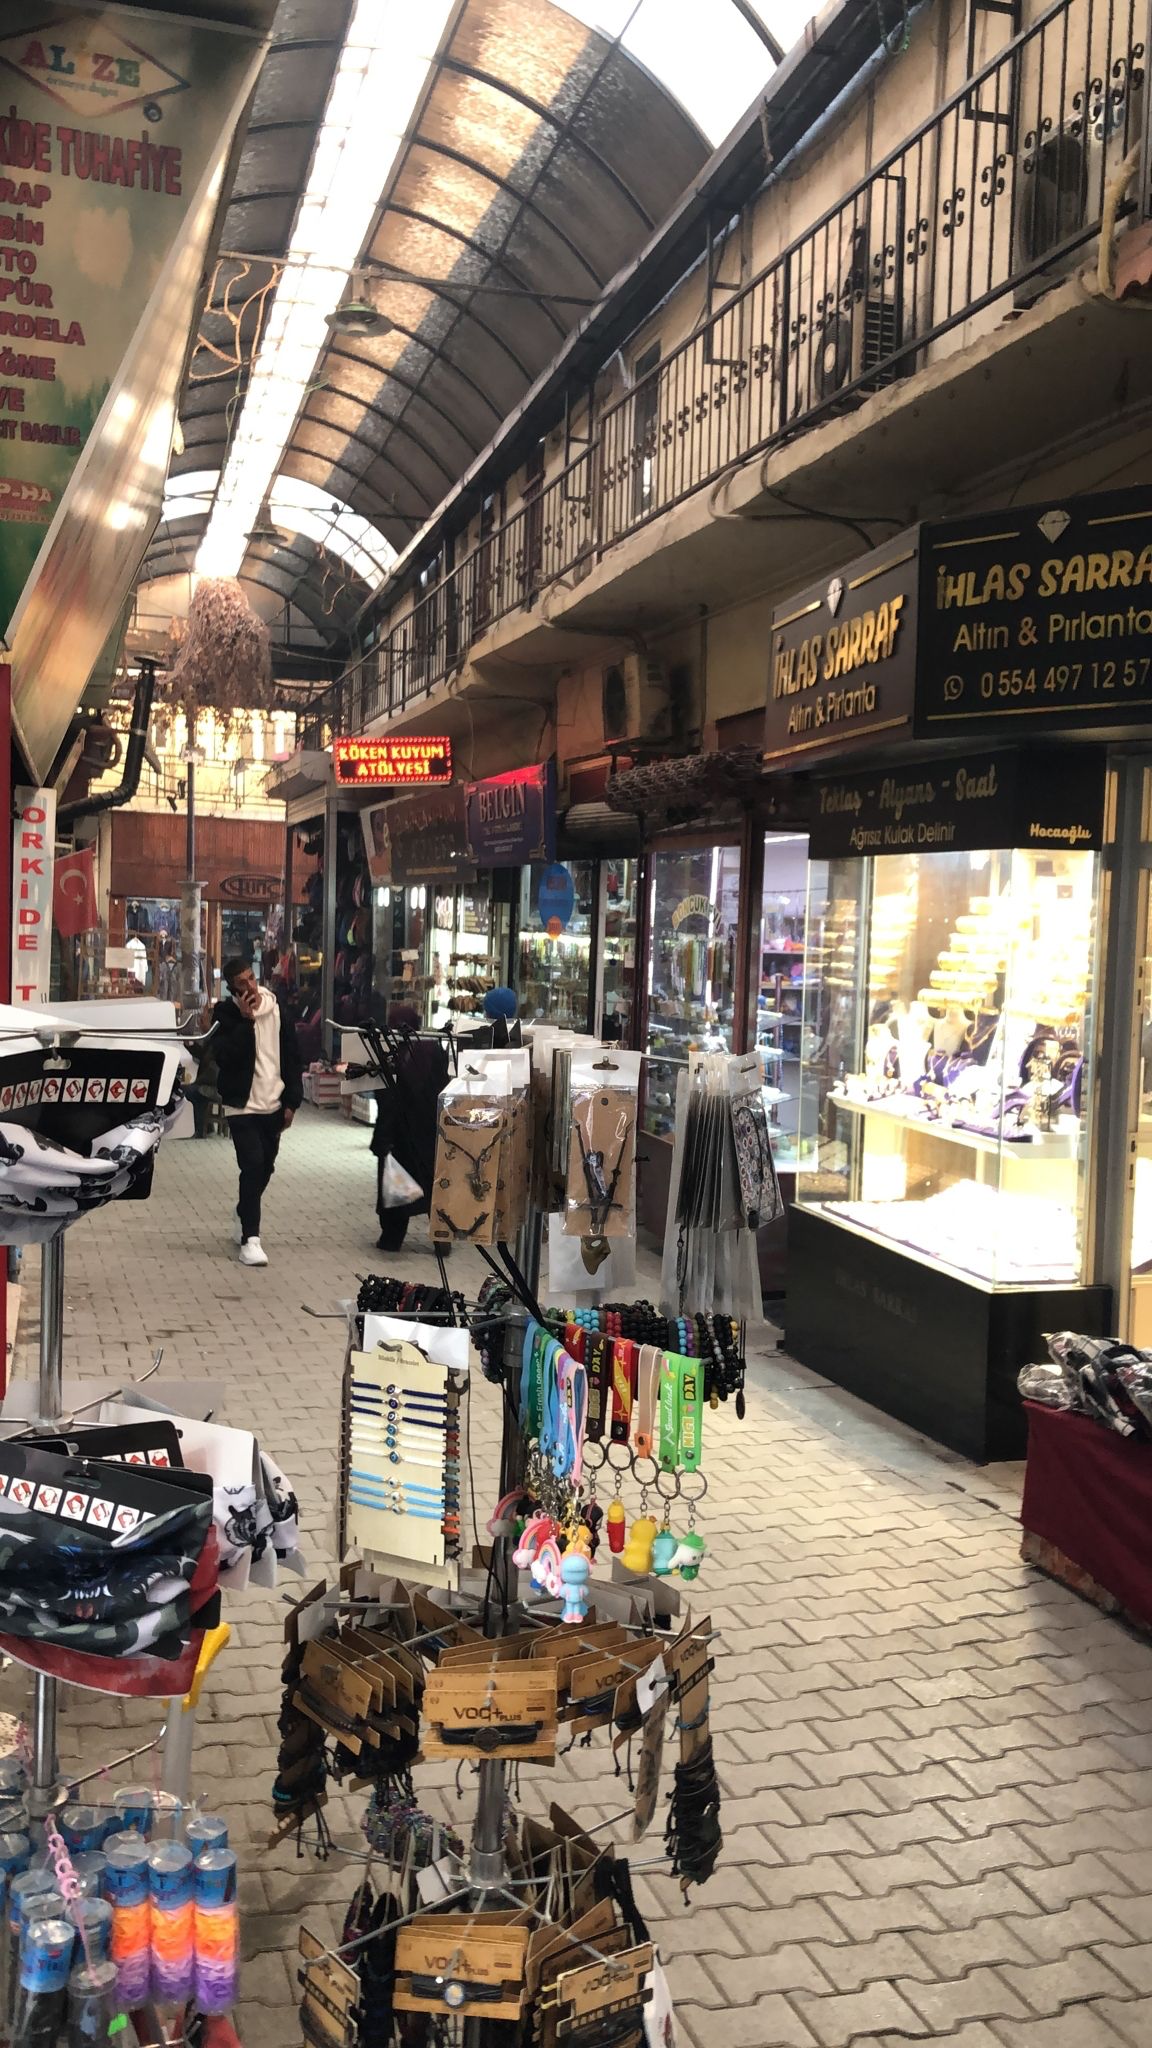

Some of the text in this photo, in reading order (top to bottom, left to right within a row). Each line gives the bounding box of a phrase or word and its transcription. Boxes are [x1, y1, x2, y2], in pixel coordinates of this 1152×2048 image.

[57, 129, 182, 196] TUHAFİYE
[936, 563, 1031, 610] İHLAS
[773, 594, 904, 698] İHLAS SARRAF
[953, 622, 1009, 652] Altın
[1018, 616, 1039, 646] &
[980, 657, 1151, 698] 0 554 497 12 57
[815, 696, 826, 728] &
[827, 681, 876, 722] Pırlanta
[339, 744, 444, 761] KÖKEN KUYUM
[357, 759, 430, 777] ATÖLYESİ
[955, 763, 999, 801] Saat
[479, 780, 527, 823] BELGİN
[884, 823, 914, 845] Kulak
[917, 821, 956, 843] Delinir
[1029, 823, 1092, 844] Hocaoğlu
[18, 807, 46, 951] ORKİDE
[592, 1348, 601, 1373] DAY
[683, 1373, 695, 1401] DAY
